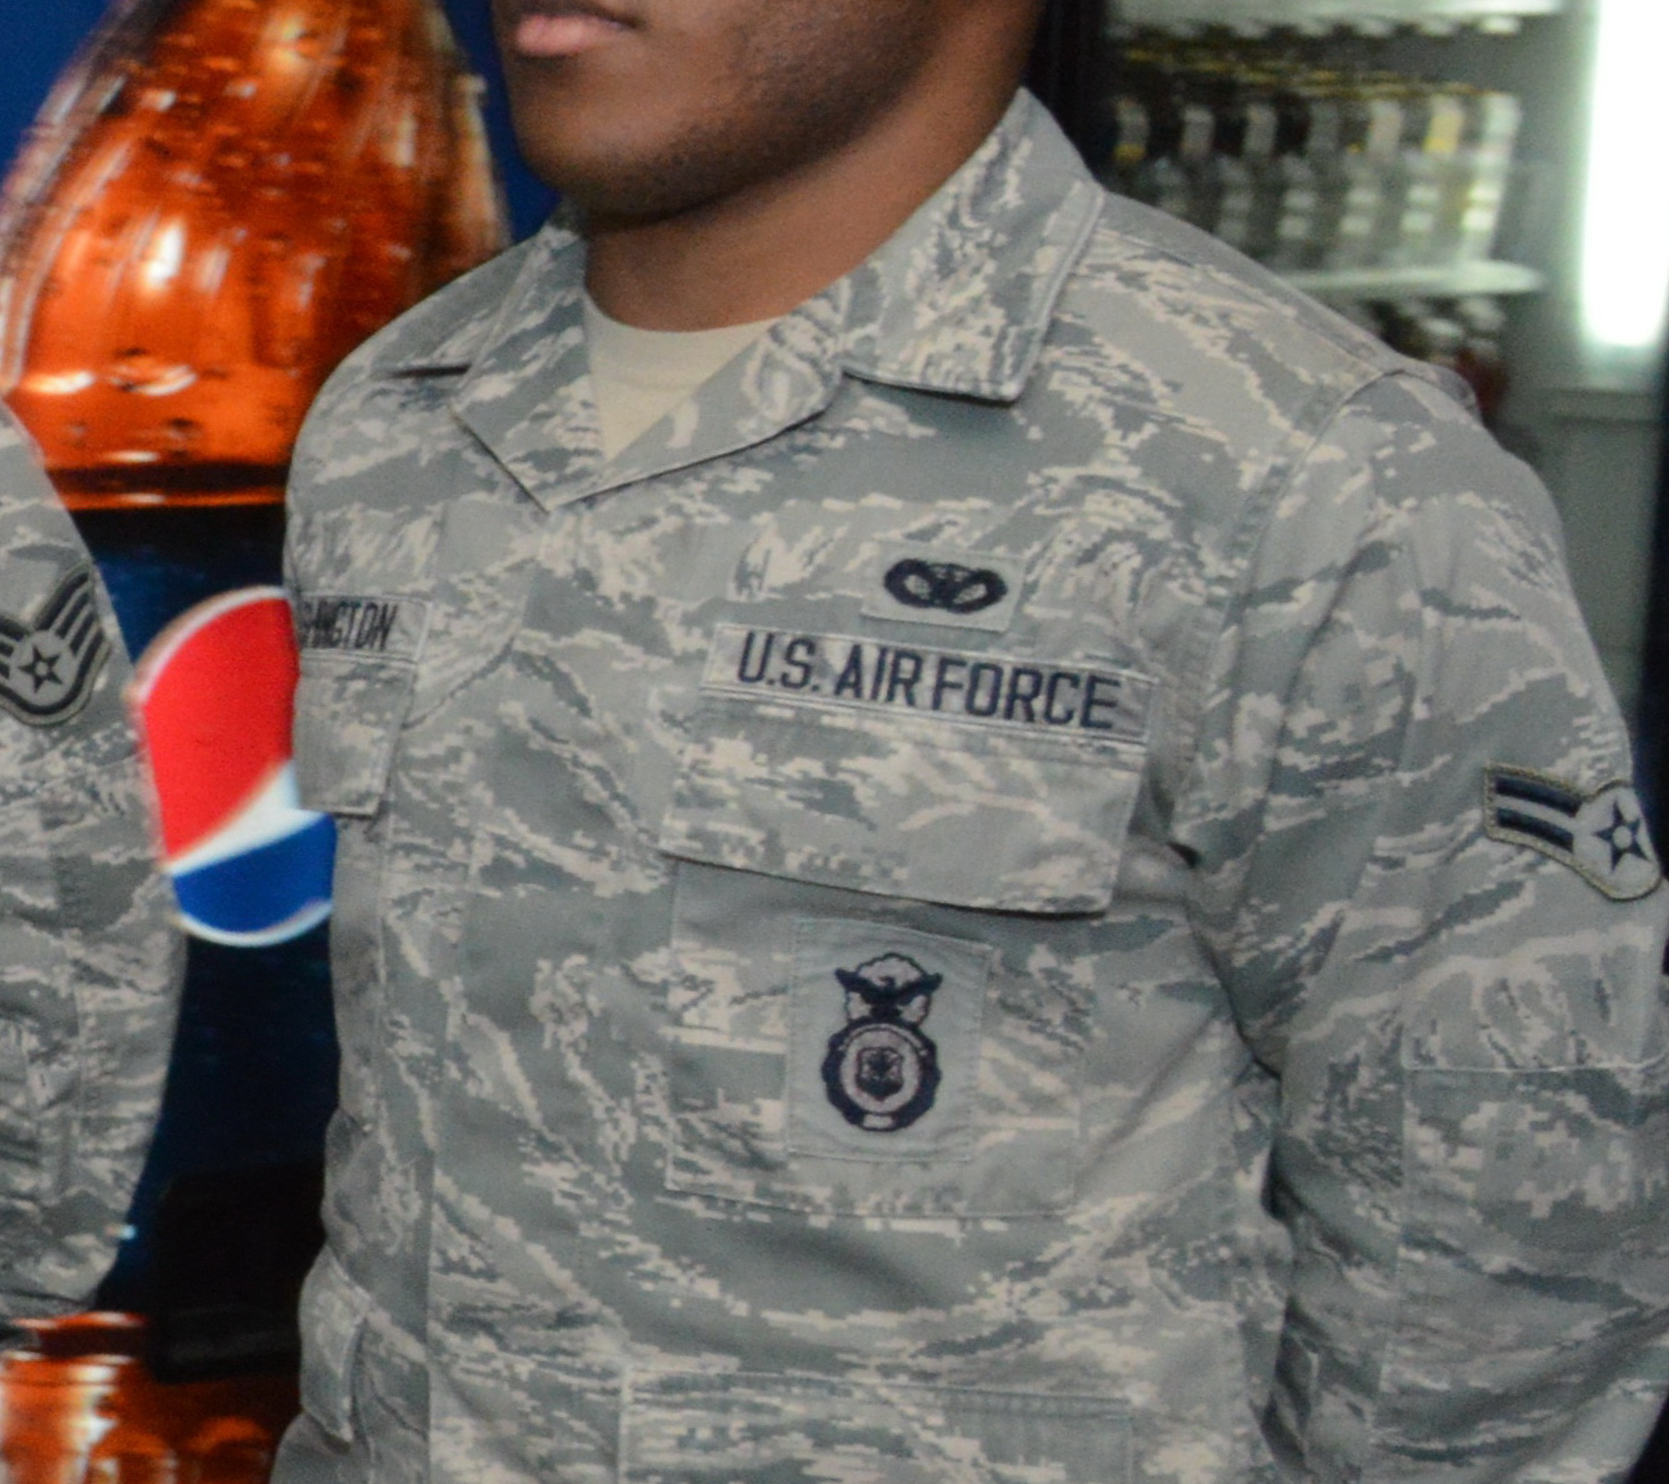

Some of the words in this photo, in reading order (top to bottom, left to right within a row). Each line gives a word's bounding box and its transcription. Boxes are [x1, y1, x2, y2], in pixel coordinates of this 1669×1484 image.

[737, 630, 822, 692] U.S.
[833, 642, 923, 708] AIR
[931, 656, 1122, 730] FORCE
